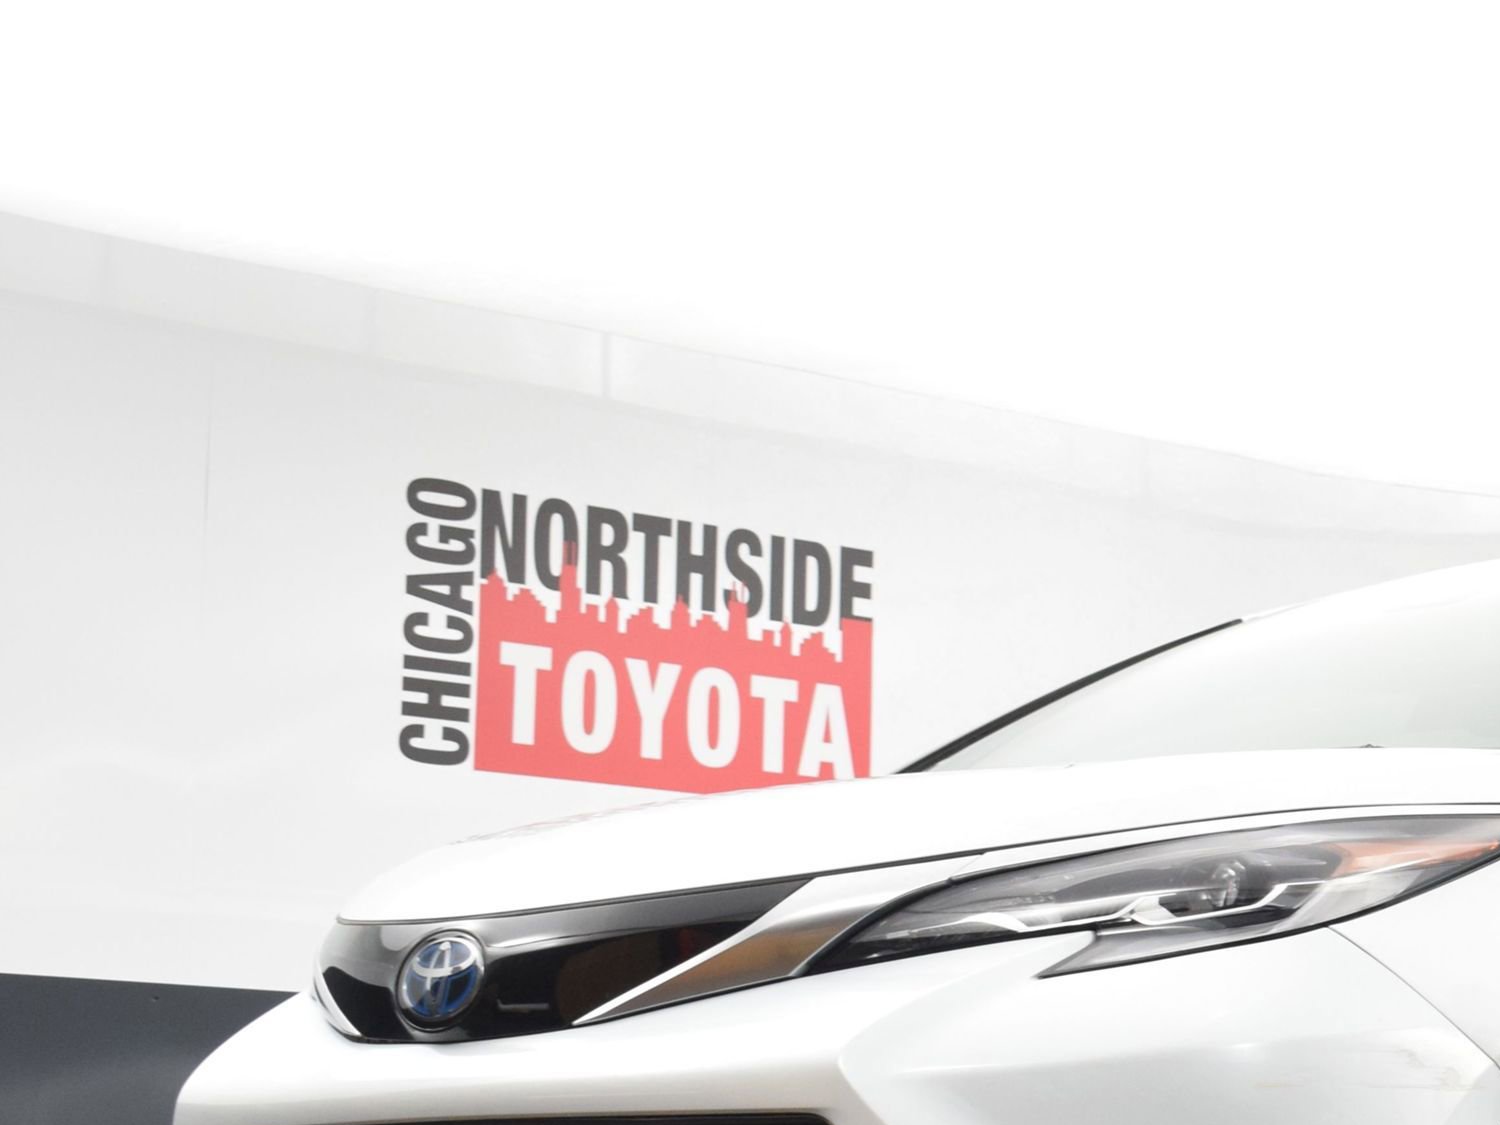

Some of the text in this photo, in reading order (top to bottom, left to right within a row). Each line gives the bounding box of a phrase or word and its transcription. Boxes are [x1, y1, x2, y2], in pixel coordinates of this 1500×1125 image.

[399, 477, 476, 766] CHICAGO
[480, 488, 873, 630] NORTHSIDE
[499, 641, 855, 779] TOYOTA
